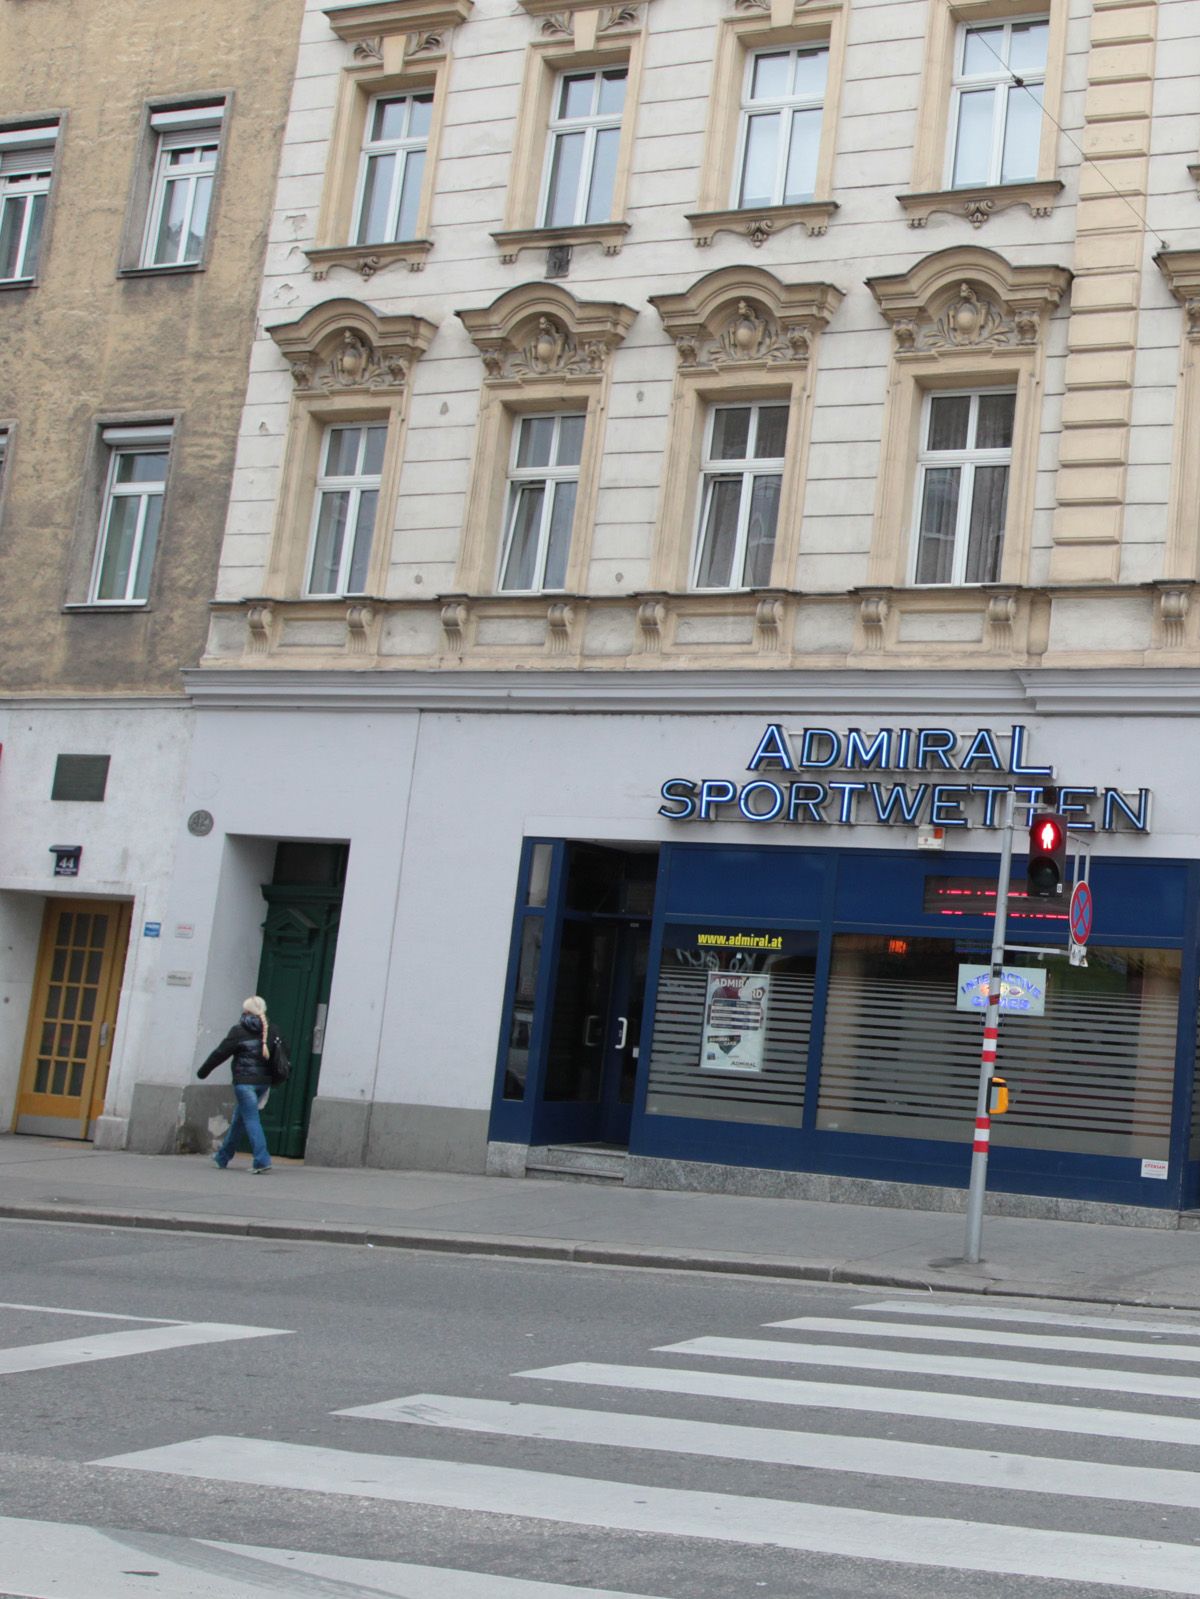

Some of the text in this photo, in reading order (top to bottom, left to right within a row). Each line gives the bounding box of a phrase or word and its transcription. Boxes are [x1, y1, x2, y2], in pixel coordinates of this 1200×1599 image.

[746, 723, 1055, 778] ADMIRAL
[657, 778, 1152, 833] SPORTWETTEN
[59, 856, 75, 868] 44
[697, 932, 783, 949] www.admiral.at
[961, 972, 1042, 999] INTEACTIVE
